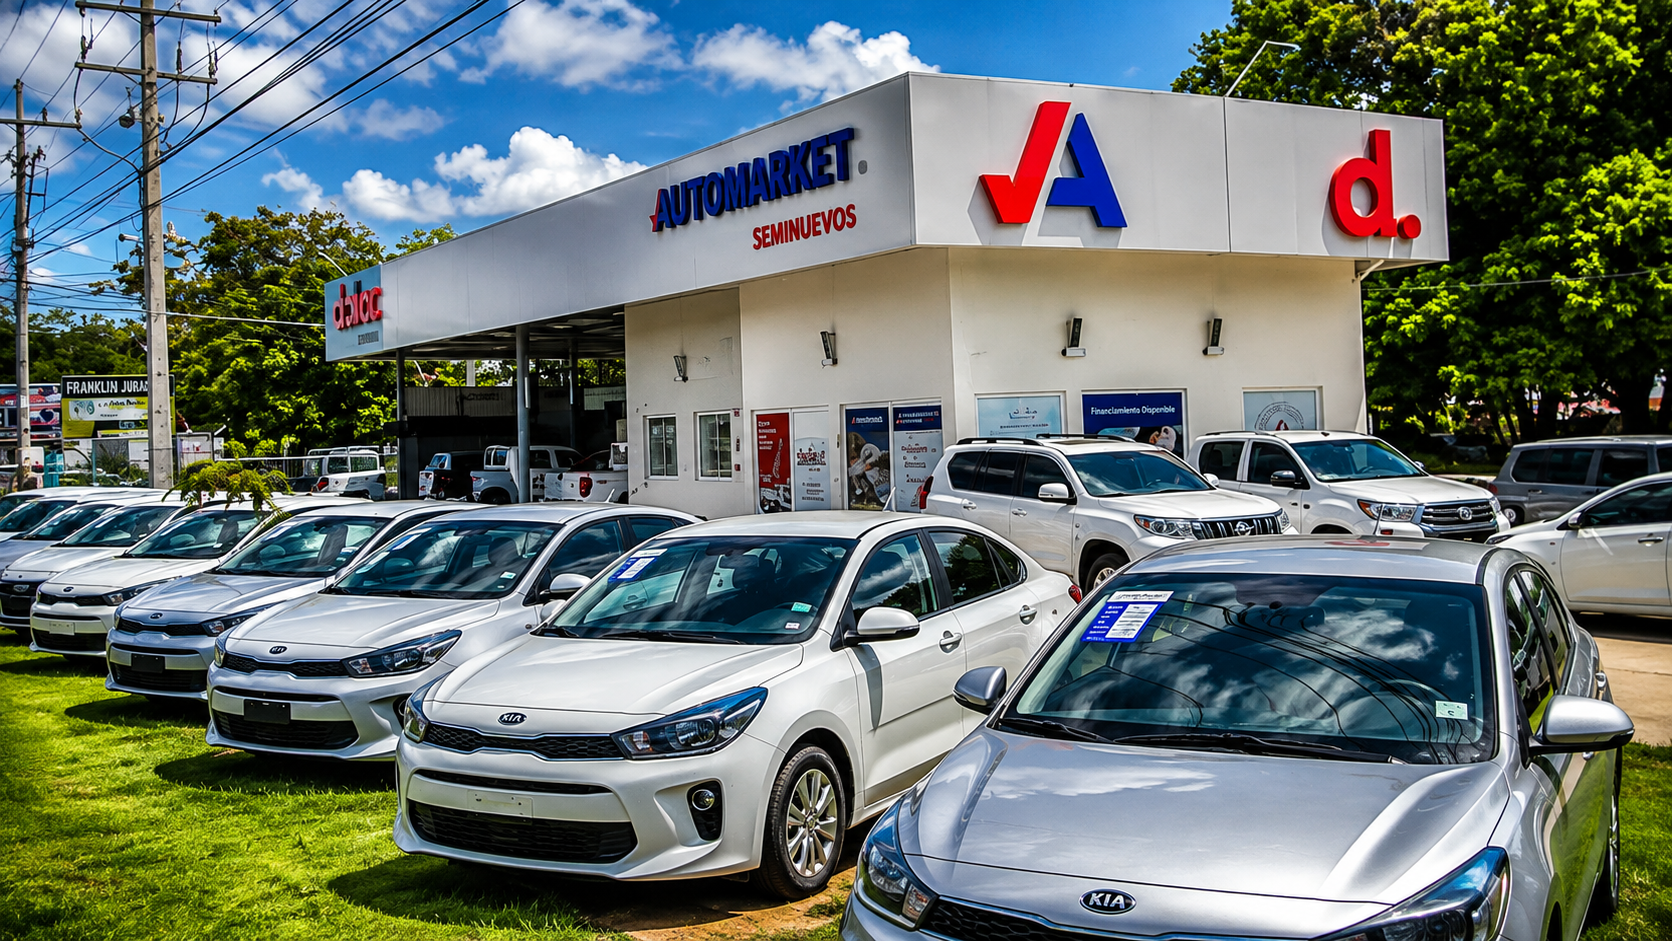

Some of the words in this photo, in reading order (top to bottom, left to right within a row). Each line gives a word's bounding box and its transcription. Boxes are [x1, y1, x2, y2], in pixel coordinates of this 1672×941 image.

[649, 127, 854, 232] AUTOMARKET
[753, 203, 857, 250] SEMINUEVOS
[66, 380, 118, 395] FRANKLIN
[501, 713, 523, 722] KIA
[1088, 892, 1126, 909] KIA
